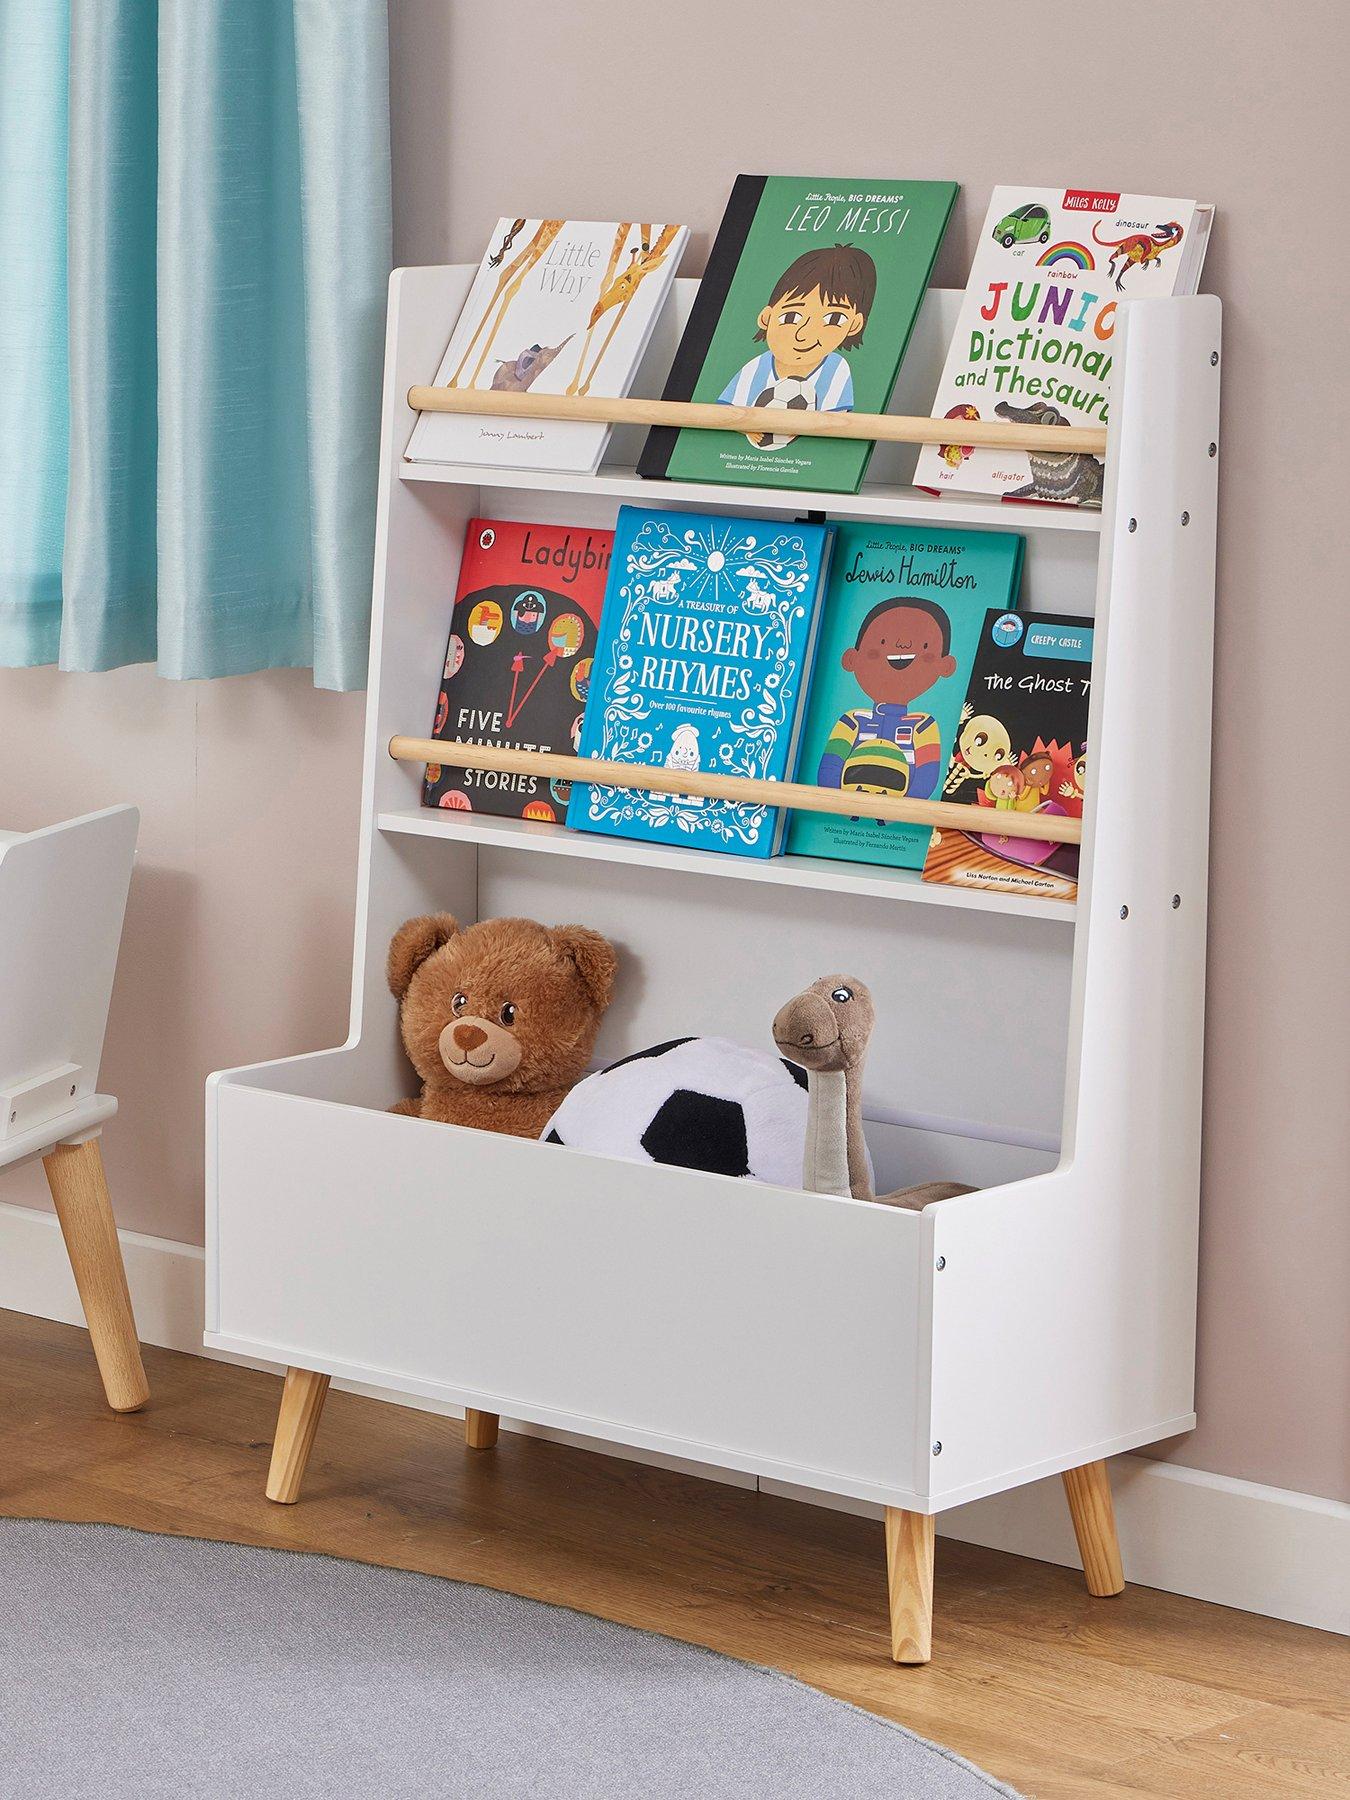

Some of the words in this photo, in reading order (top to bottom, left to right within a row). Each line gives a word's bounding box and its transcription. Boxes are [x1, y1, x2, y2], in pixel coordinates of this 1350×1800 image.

[806, 193, 823, 201] Little
[848, 195, 863, 203] BIG
[785, 205, 831, 232] LEO
[836, 208, 910, 235] MESSI
[1115, 219, 1149, 229] dinosaur
[545, 240, 601, 268] Little
[1047, 270, 1078, 279] rainbow
[538, 267, 593, 302] Why
[954, 368, 988, 387] and
[939, 471, 954, 480] hair
[991, 471, 1025, 481] alligator
[909, 543, 925, 552] BIG
[846, 551, 895, 584] Lewis
[899, 555, 978, 589] Hamilton
[678, 600, 684, 608] A
[686, 600, 725, 613] TREASURY
[726, 605, 739, 614] OF
[637, 611, 773, 660] NURSERY
[1030, 635, 1057, 646] CREEPY
[1058, 638, 1083, 649] CASTLE
[638, 656, 753, 701] RHYMES
[984, 673, 1013, 691] The
[1018, 673, 1075, 694] Ghost
[649, 700, 664, 710] Over
[665, 701, 676, 711] 100
[677, 702, 707, 715] favourite
[708, 708, 732, 719] rhymes
[457, 708, 503, 733] FIVE
[463, 768, 538, 795] STORIES
